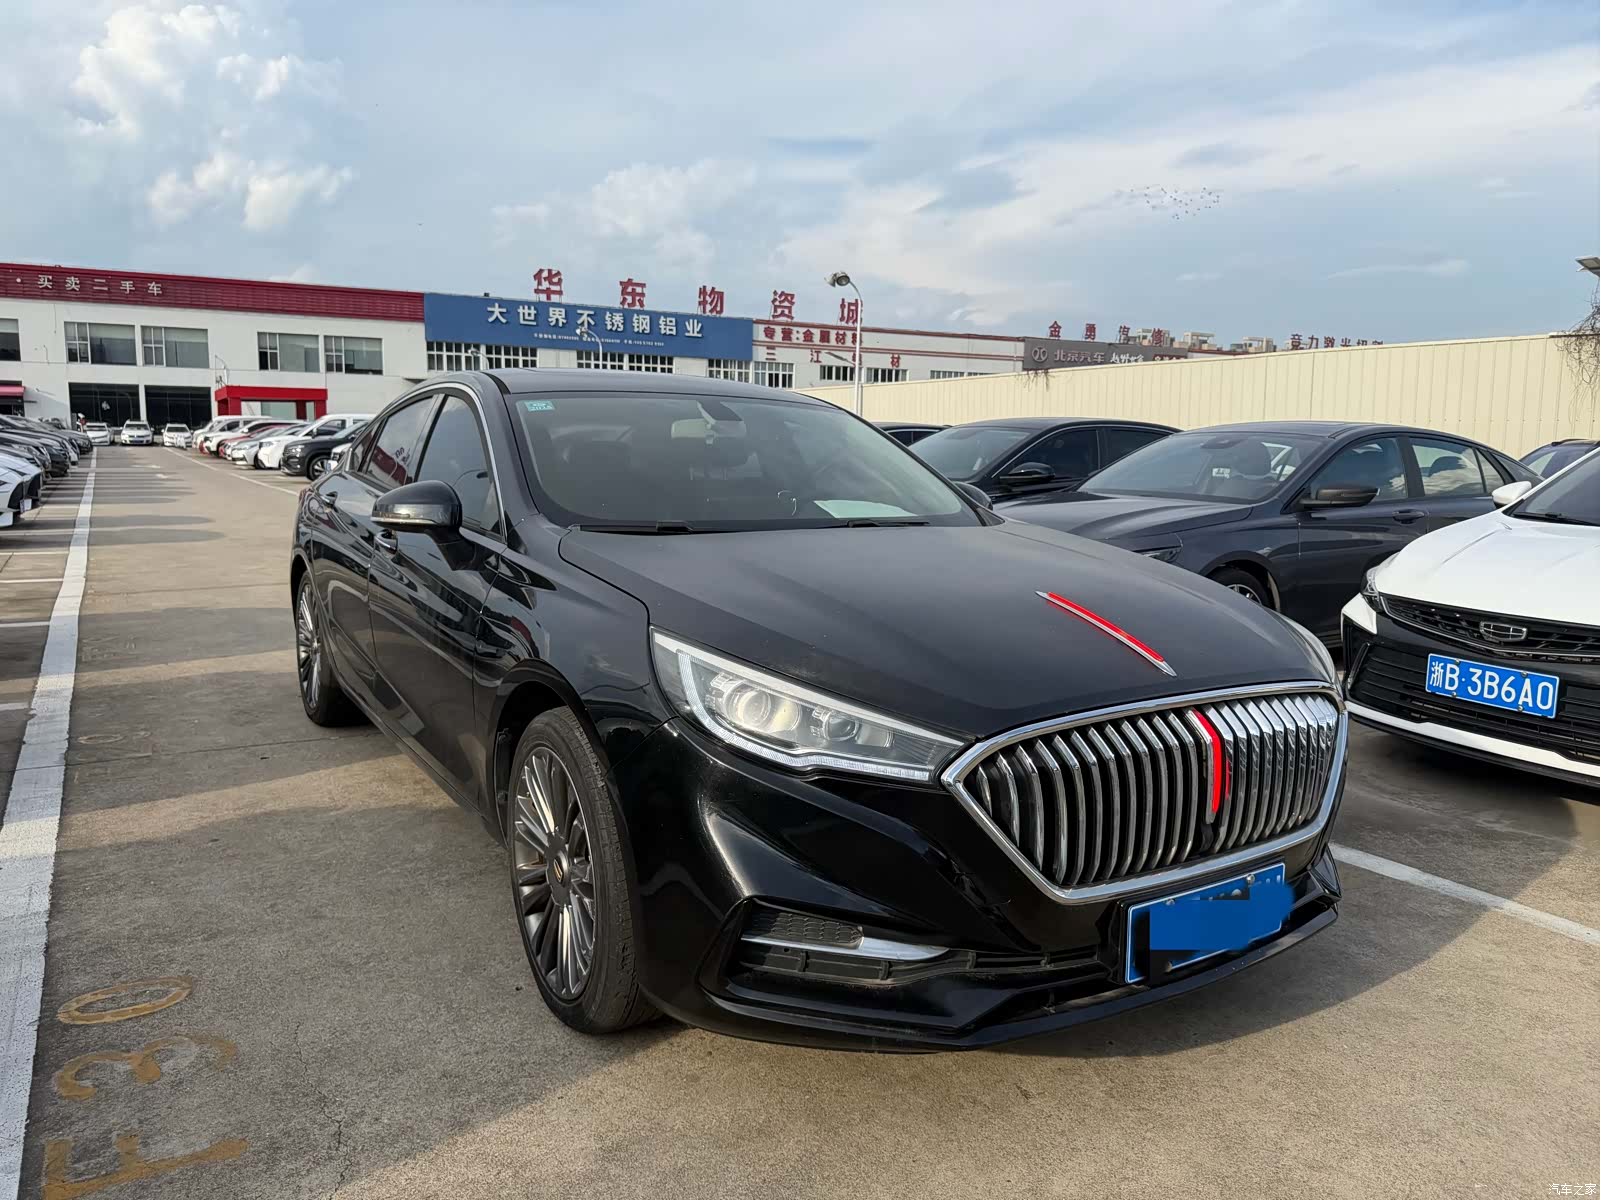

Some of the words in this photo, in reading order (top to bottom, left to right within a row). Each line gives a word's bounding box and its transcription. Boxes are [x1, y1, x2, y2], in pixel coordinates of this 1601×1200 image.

[533, 268, 862, 326] 华东物资城
[487, 302, 703, 338] 大世界不锈钢铝业
[1054, 349, 1105, 363] 北京汽车
